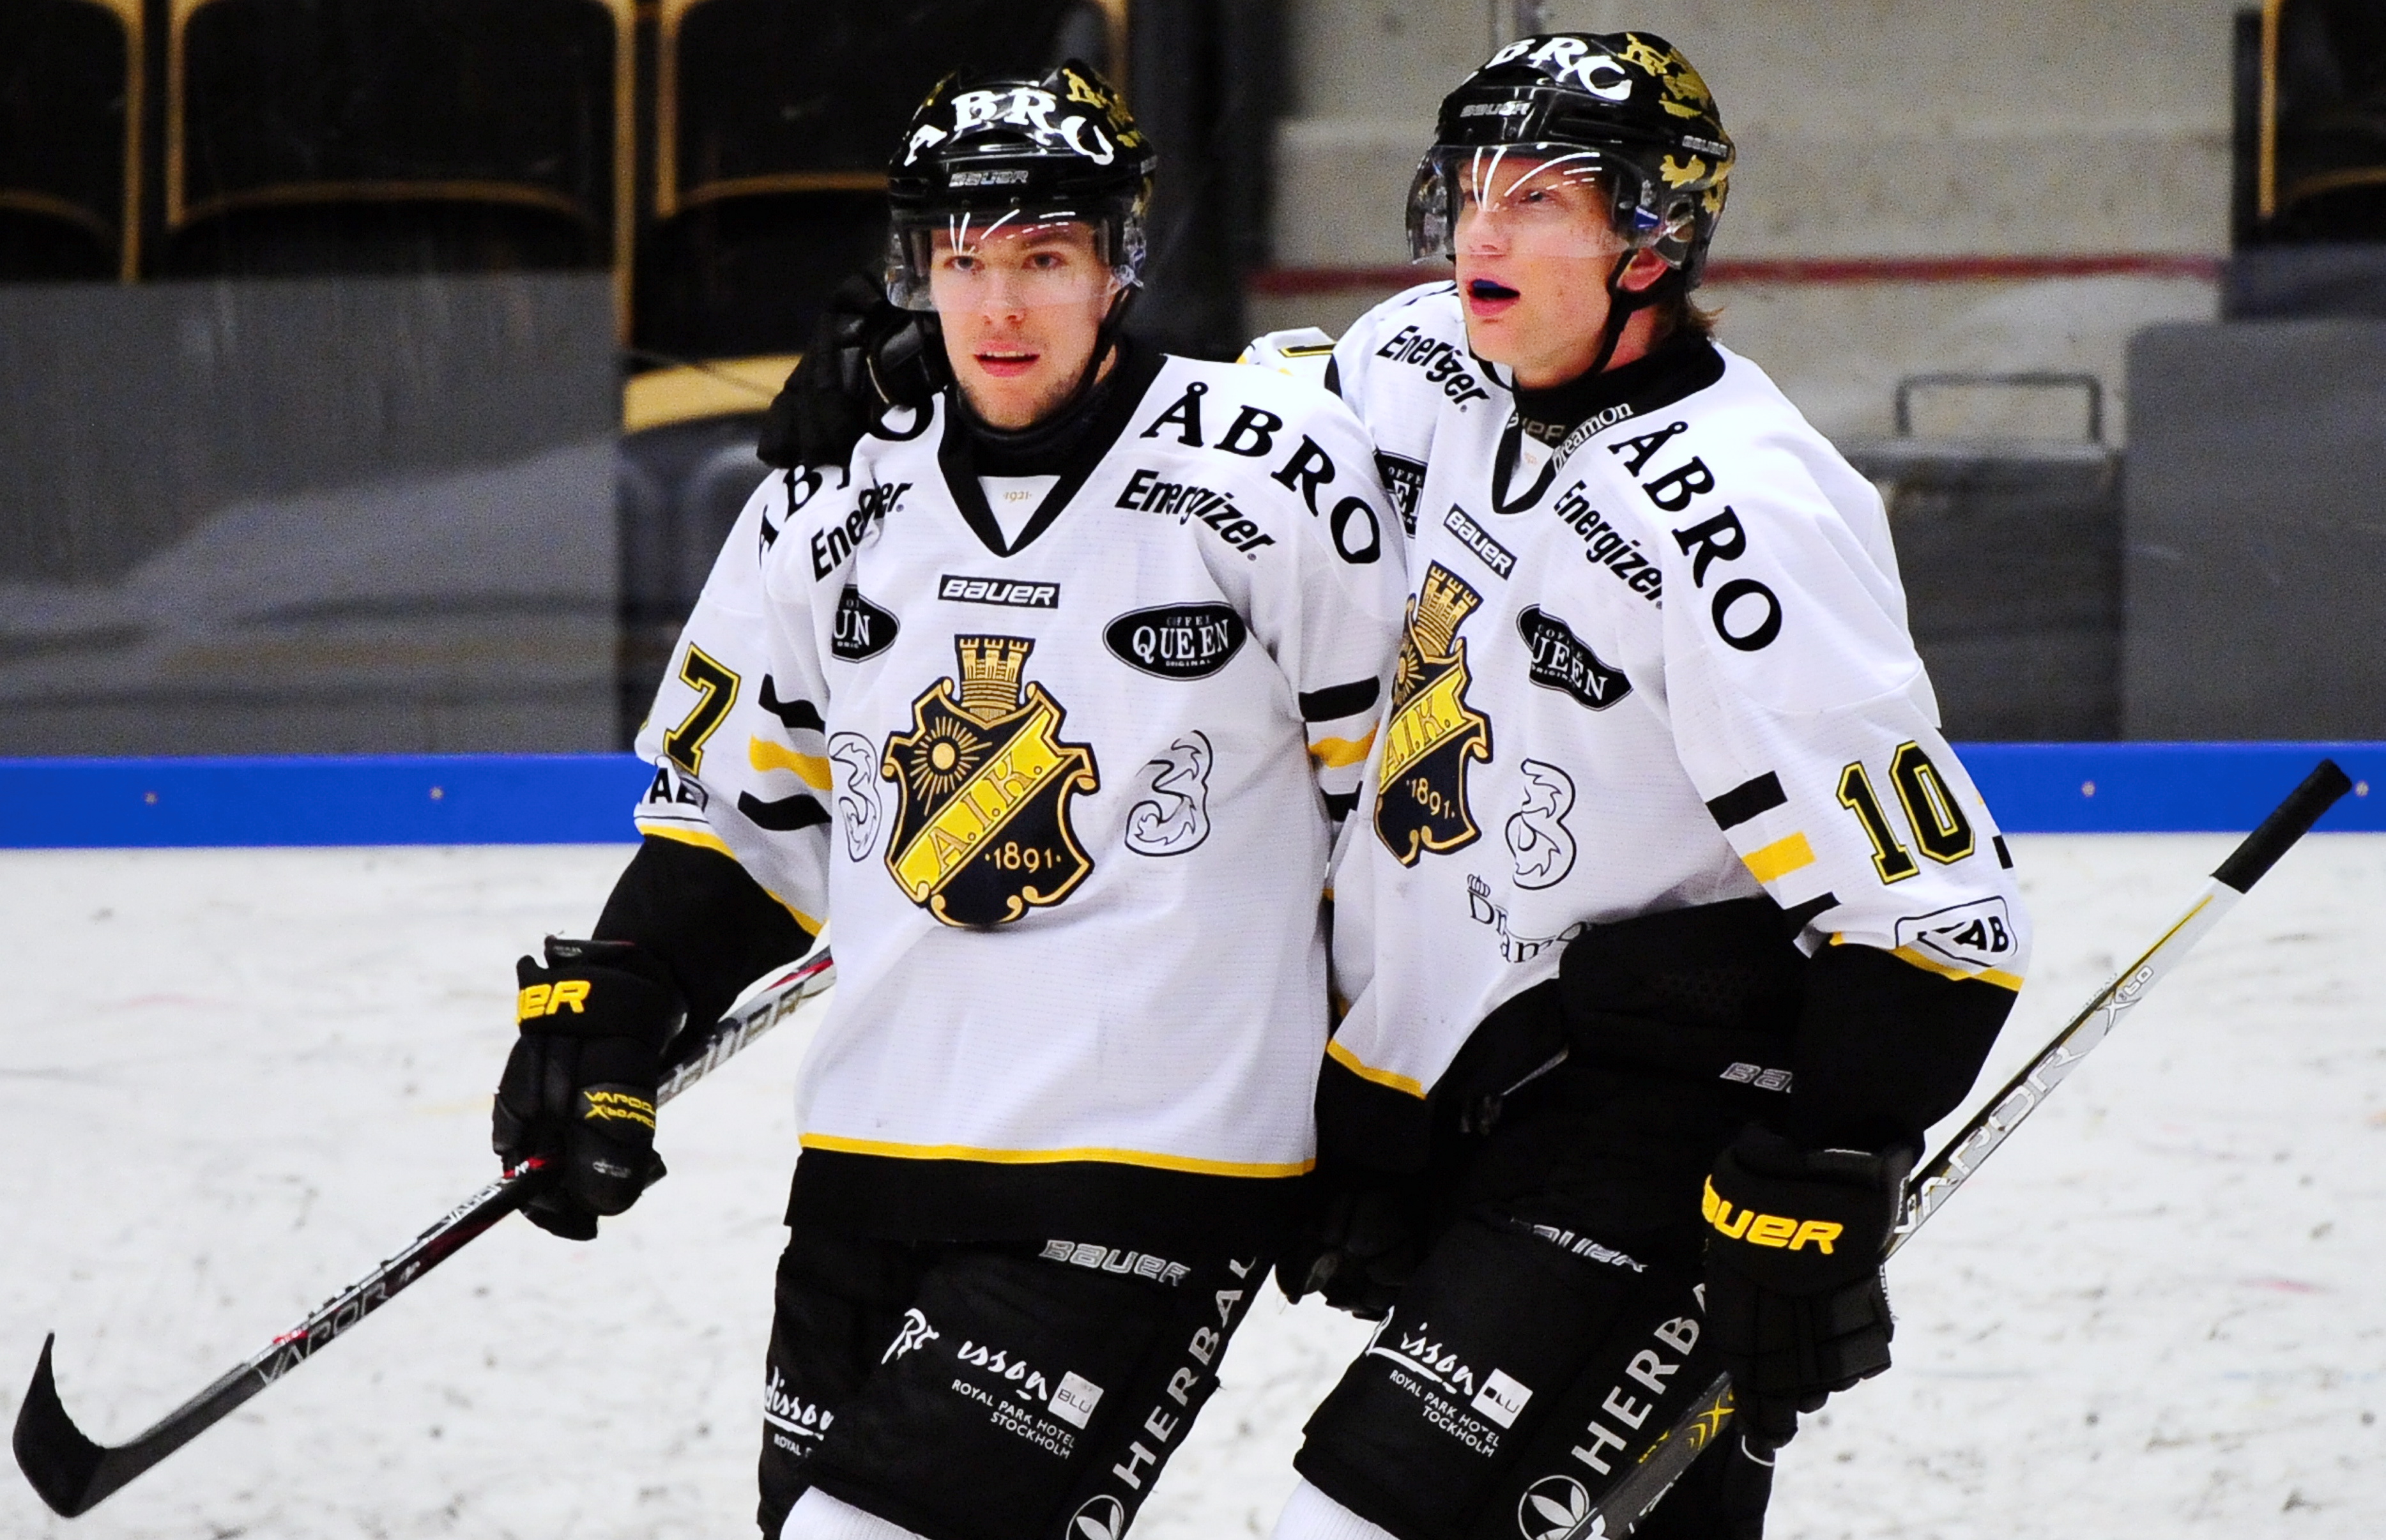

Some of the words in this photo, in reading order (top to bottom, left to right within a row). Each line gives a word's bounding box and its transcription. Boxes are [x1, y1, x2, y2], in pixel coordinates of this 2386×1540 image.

[1140, 381, 1380, 564] ÅBRO
[1115, 468, 1276, 553] Energizer
[1607, 420, 1783, 652] ÅBRO
[1132, 618, 1229, 664] QUEEN
[1532, 632, 1609, 700] UEEN
[1835, 740, 1975, 885] 10
[951, 1378, 993, 1407] ROYAL
[998, 1400, 1032, 1425] PARK
[1036, 1419, 1076, 1448] HOTEL
[990, 1412, 1071, 1460] STOCKHOLM
[1057, 1389, 1092, 1414] BLU
[1389, 1369, 1422, 1398] ROYAL
[1424, 1392, 1458, 1419] PARK
[1458, 1414, 1500, 1447] HOTEL
[1421, 1405, 1495, 1458] TOCKHOLM
[774, 1433, 801, 1456] ROYAL
